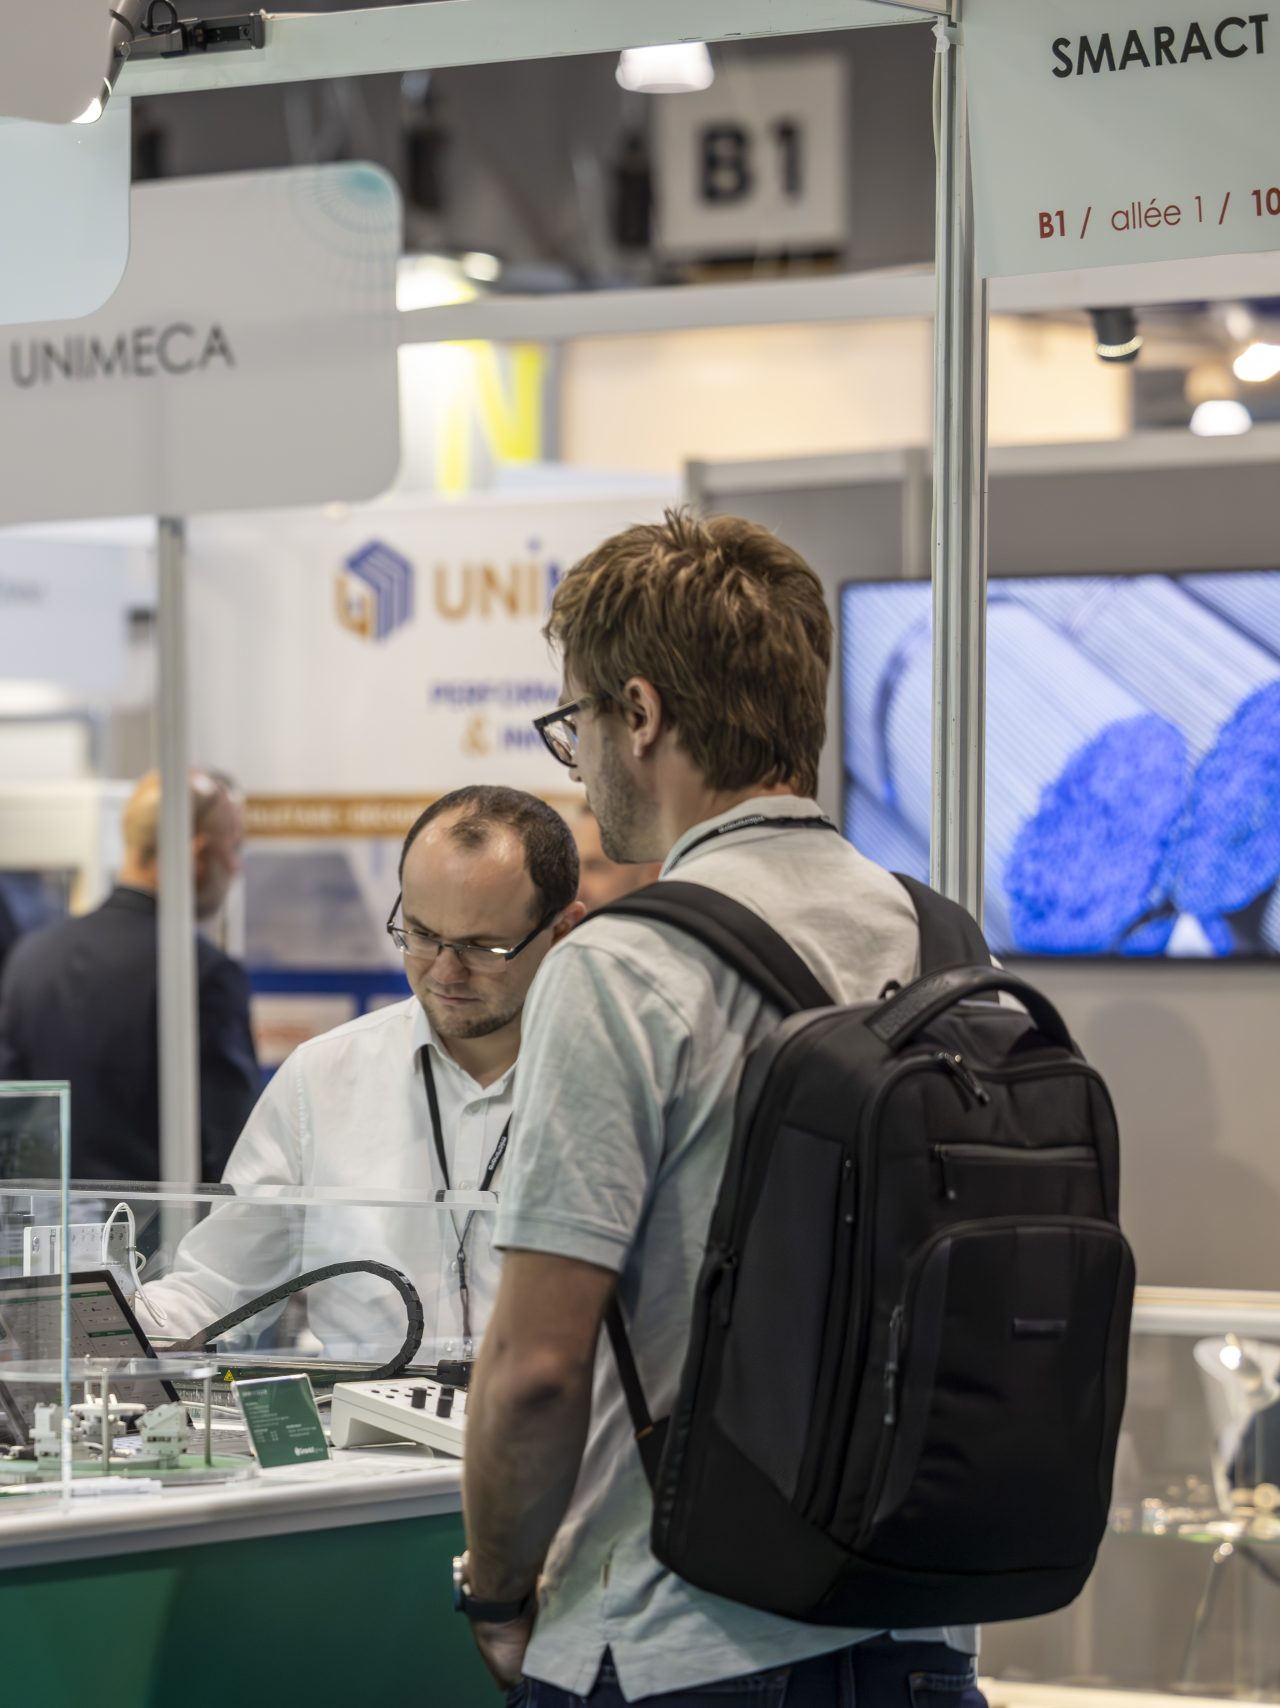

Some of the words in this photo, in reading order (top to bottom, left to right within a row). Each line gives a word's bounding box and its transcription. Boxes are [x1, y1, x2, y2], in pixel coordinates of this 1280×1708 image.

[1051, 13, 1269, 78] SMARACT
[698, 121, 803, 205] B1
[1038, 209, 1066, 239] B1
[1111, 198, 1182, 231] allée
[9, 321, 237, 390] UNIMECA
